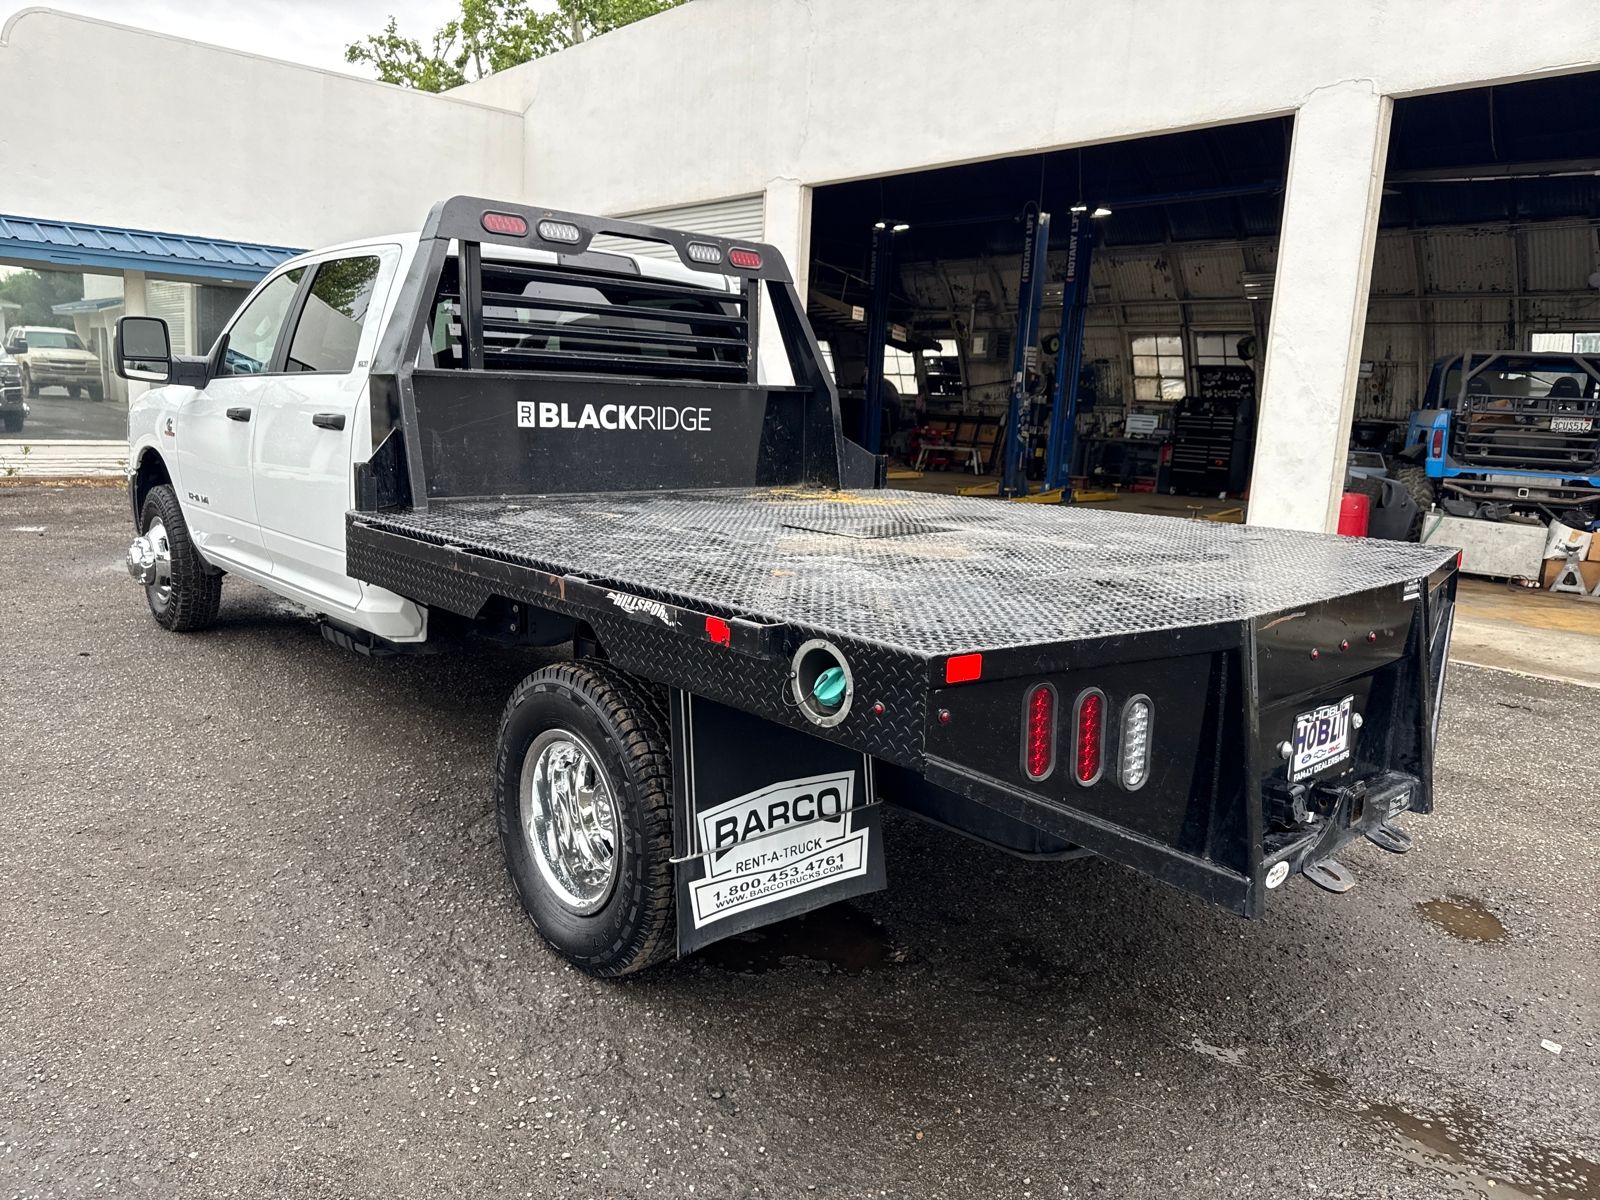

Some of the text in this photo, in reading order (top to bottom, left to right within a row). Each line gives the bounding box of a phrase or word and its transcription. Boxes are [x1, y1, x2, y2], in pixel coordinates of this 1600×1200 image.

[1022, 237, 1033, 277] ROTARY
[1067, 235, 1078, 276] ROTARY
[539, 402, 712, 431] BLACKRIDGE
[1552, 421, 1591, 432] 3CUS512
[1295, 709, 1349, 755] HOBLIT
[715, 787, 842, 862] BARCO
[736, 838, 822, 873] RENT-A-TRUCK
[713, 853, 845, 901] 1.800.453.4761
